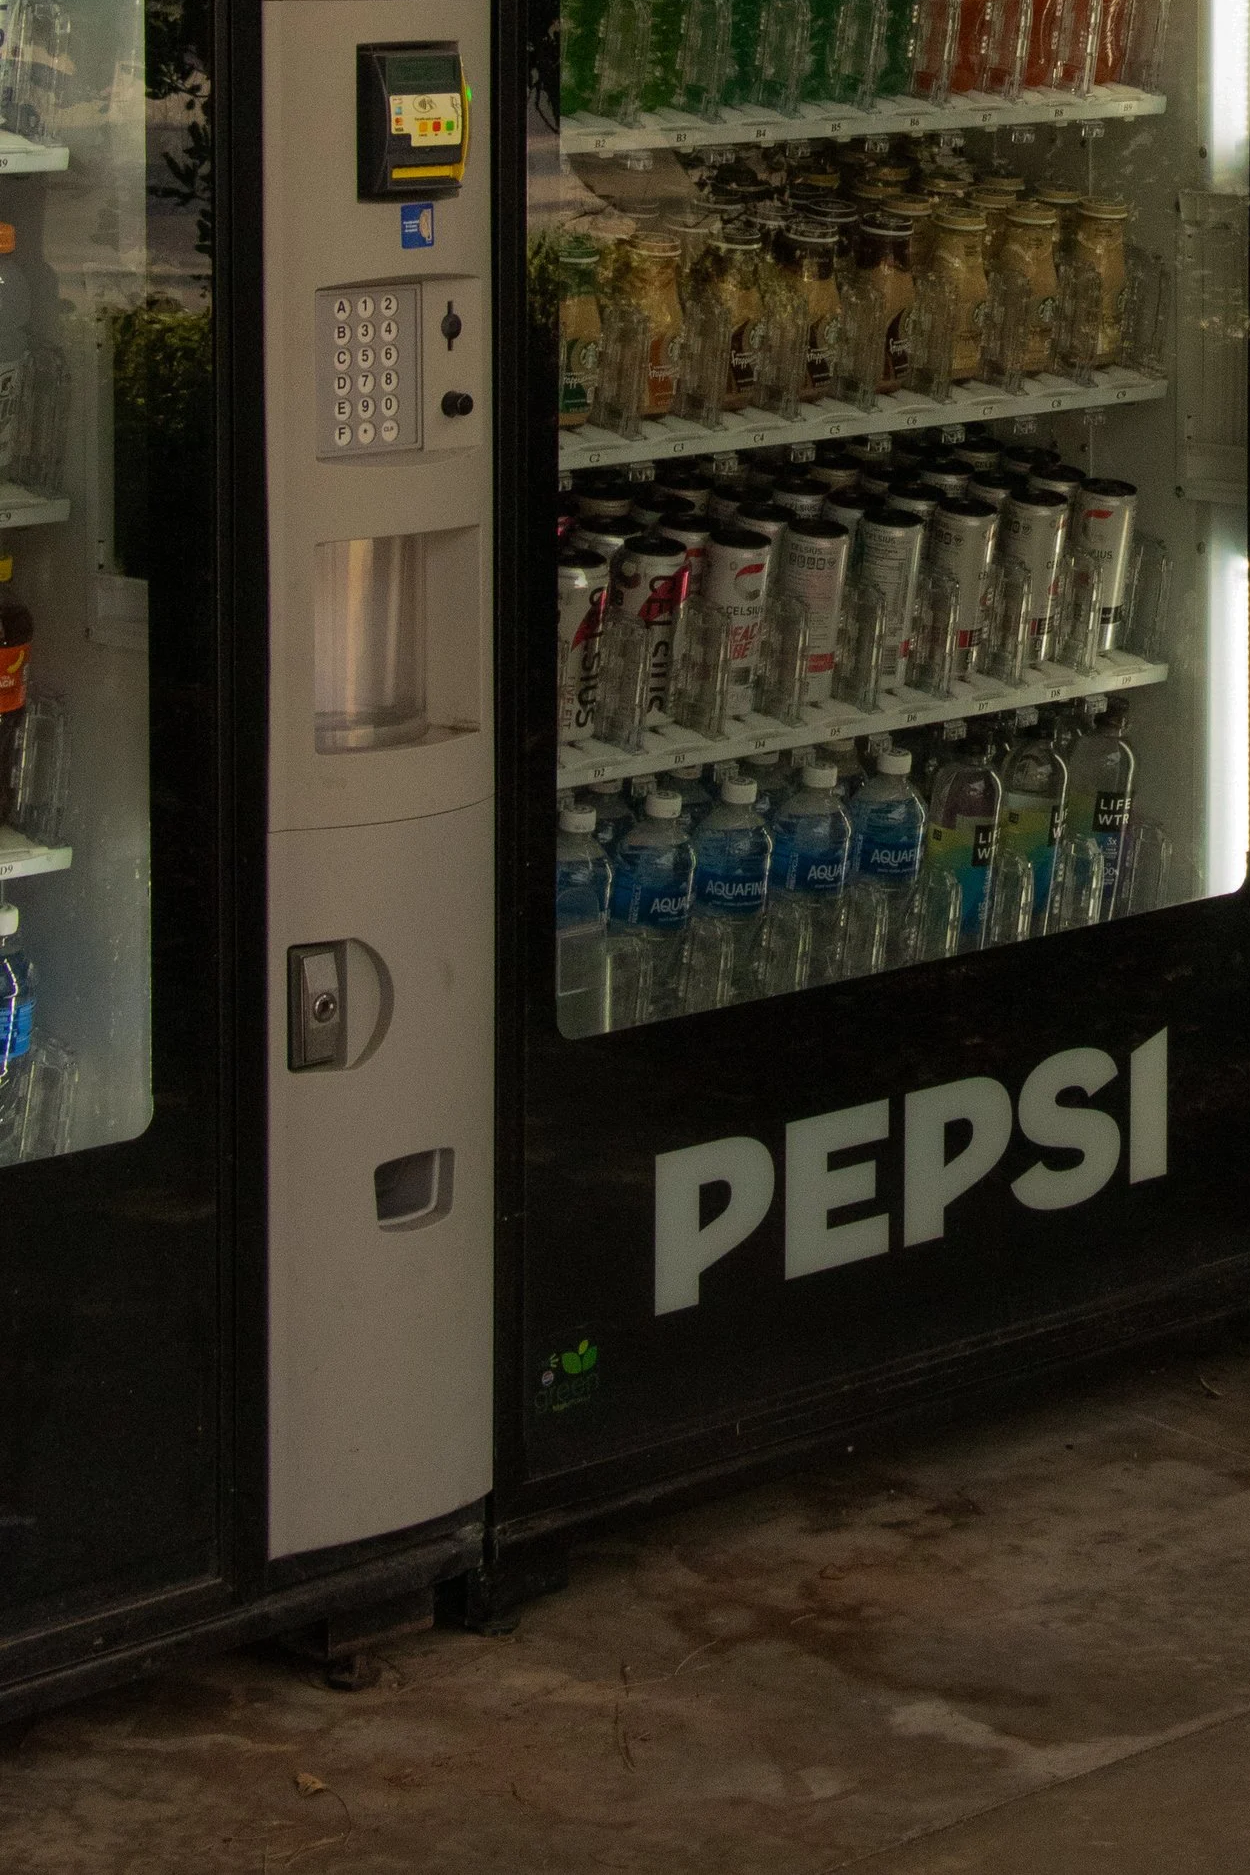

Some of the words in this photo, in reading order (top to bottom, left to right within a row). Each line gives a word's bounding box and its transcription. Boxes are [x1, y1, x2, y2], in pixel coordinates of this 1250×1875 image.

[982, 113, 992, 123] B7
[1054, 108, 1064, 118] B8
[910, 118, 920, 127] B6
[832, 123, 842, 133] B5
[756, 128, 766, 139] B4
[595, 138, 606, 149] B2
[676, 134, 687, 144] B3
[337, 300, 346, 313] A
[384, 297, 392, 310] 2
[337, 326, 346, 339] B
[362, 324, 368, 337] 3
[384, 322, 392, 335] 4
[337, 351, 346, 364] C
[362, 350, 369, 362] 5
[385, 348, 392, 361] 6
[337, 377, 346, 389] D
[362, 375, 369, 387] 7
[385, 372, 392, 385] 8
[1116, 390, 1127, 400] C9
[338, 402, 346, 414] E
[362, 400, 369, 412] 9
[1051, 399, 1062, 409] C8
[983, 406, 993, 416] C7
[906, 416, 917, 426] C6
[339, 427, 346, 440] F
[829, 424, 841, 435] C5
[754, 433, 765, 443] C4
[673, 443, 684, 453] C3
[590, 453, 601, 464] C2
[1121, 675, 1132, 685] D9
[1051, 688, 1061, 698] D8
[978, 702, 988, 712] D7
[907, 713, 917, 723] D6
[831, 728, 842, 738] D5
[755, 740, 766, 750] D4
[675, 754, 686, 765] D3
[594, 768, 605, 779] D2
[1099, 797, 1131, 811] LIFE
[1097, 813, 1130, 827] WTR
[655, 1027, 1168, 1317] PEPSI
